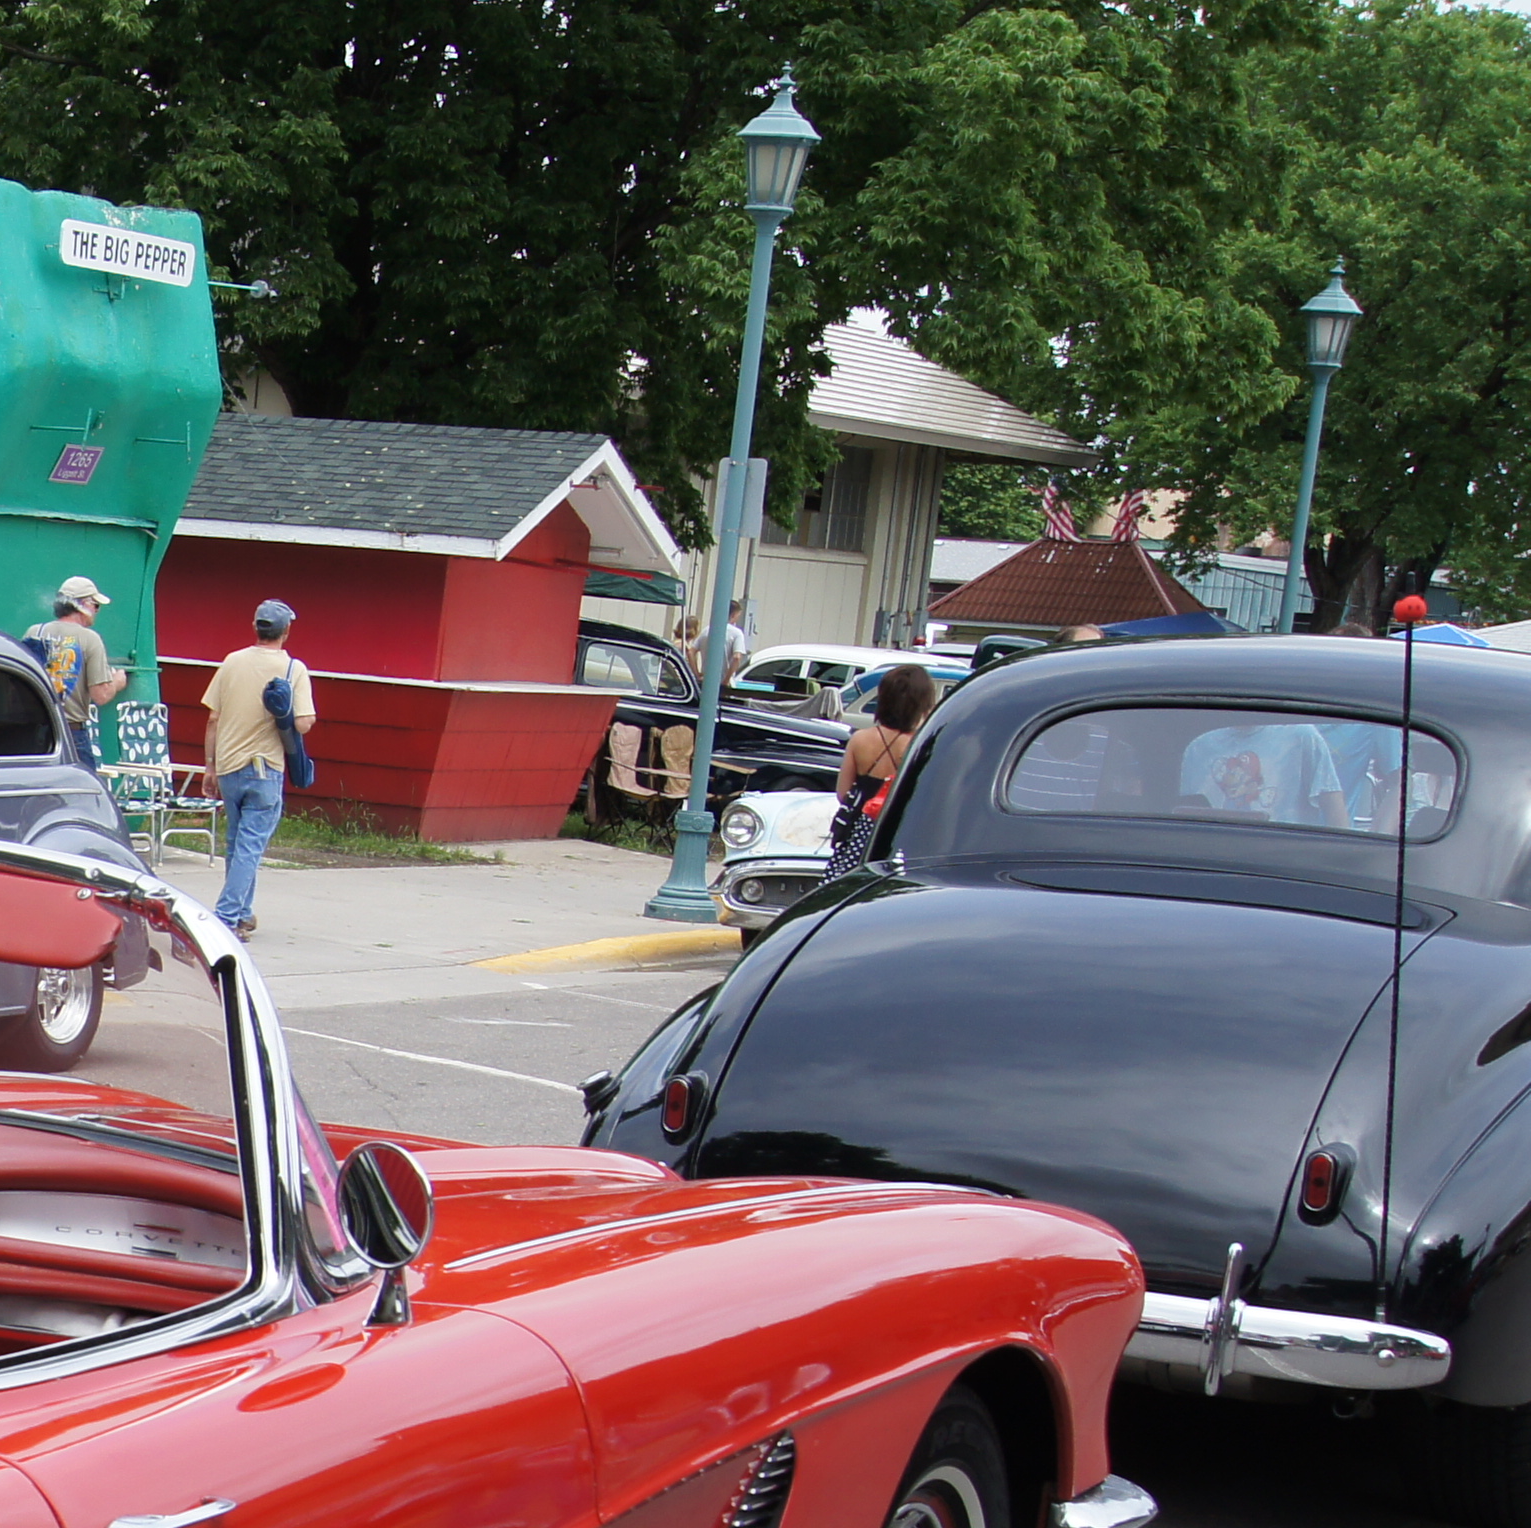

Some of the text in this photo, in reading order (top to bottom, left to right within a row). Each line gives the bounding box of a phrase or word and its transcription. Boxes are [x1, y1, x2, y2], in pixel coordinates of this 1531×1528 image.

[72, 229, 187, 278] THE BIG PEPPER
[67, 451, 95, 468] 1265
